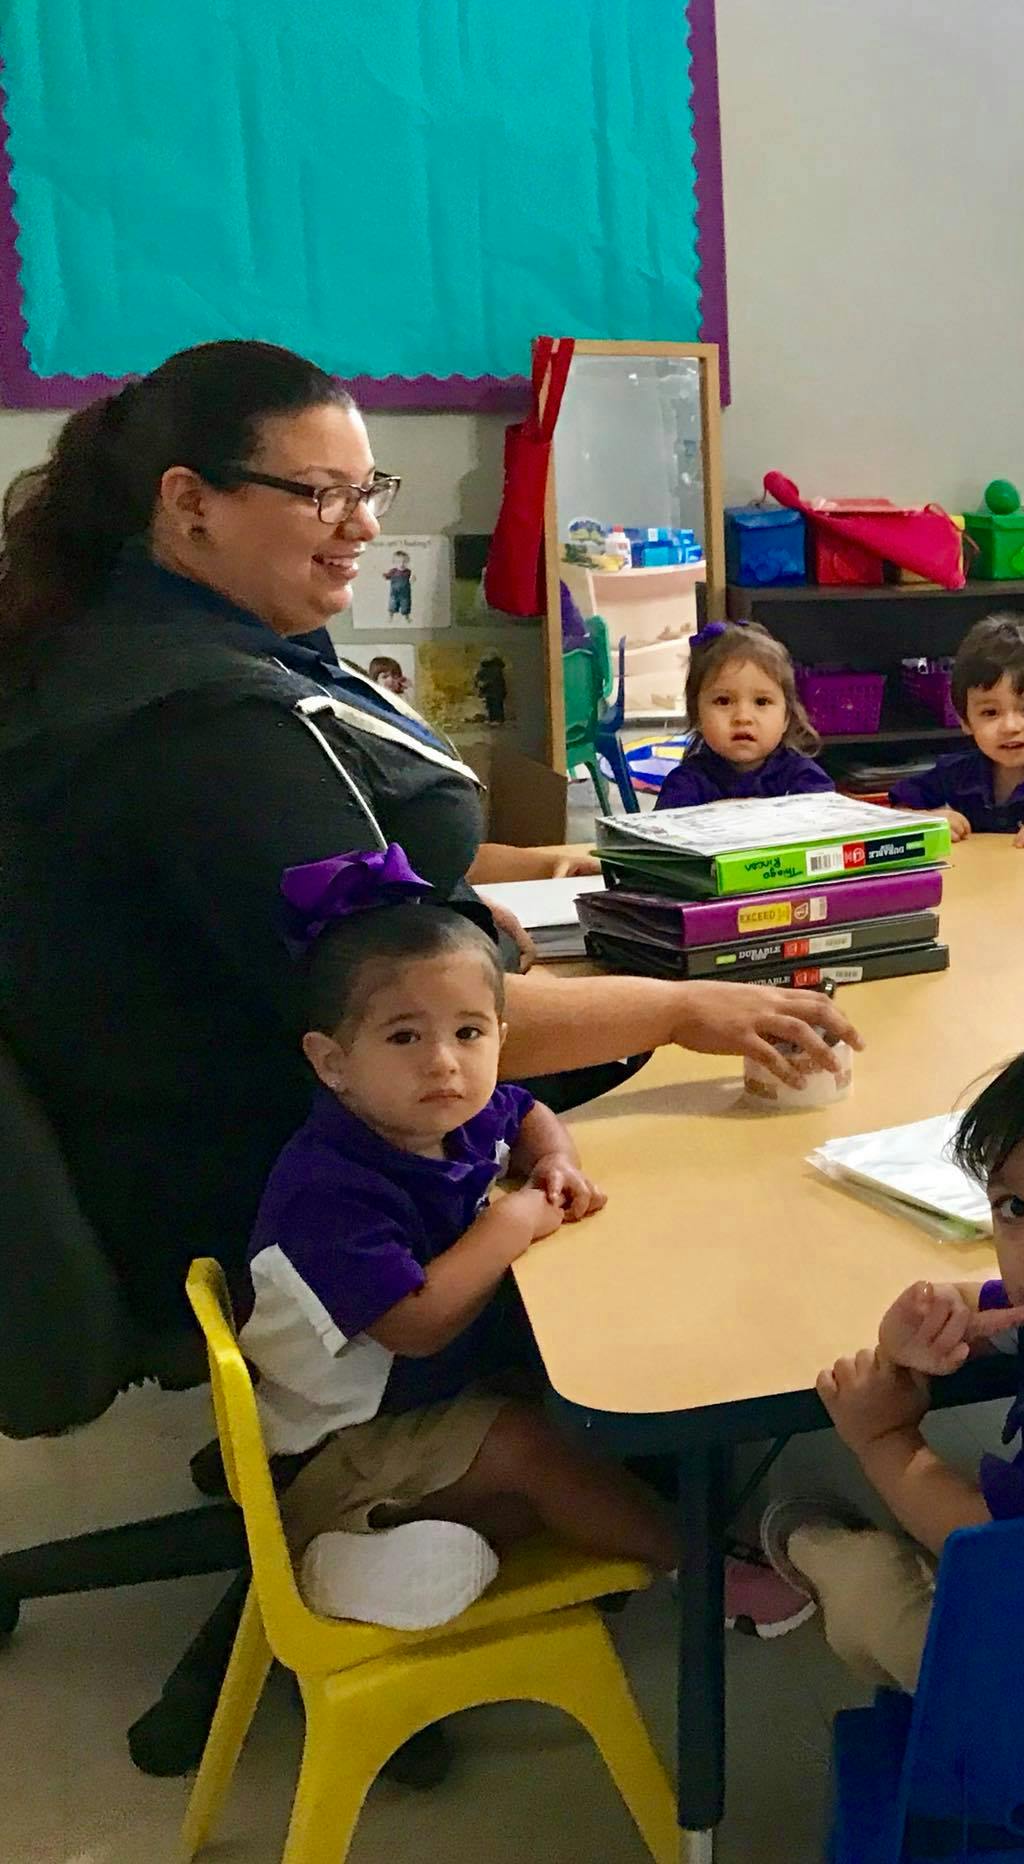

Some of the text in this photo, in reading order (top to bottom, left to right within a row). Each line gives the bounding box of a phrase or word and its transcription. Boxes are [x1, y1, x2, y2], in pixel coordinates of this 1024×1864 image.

[868, 846, 905, 859] DURABLE
[763, 867, 802, 880] Thiago
[739, 911, 776, 923] EXCEED
[738, 946, 781, 959] DURABLE
